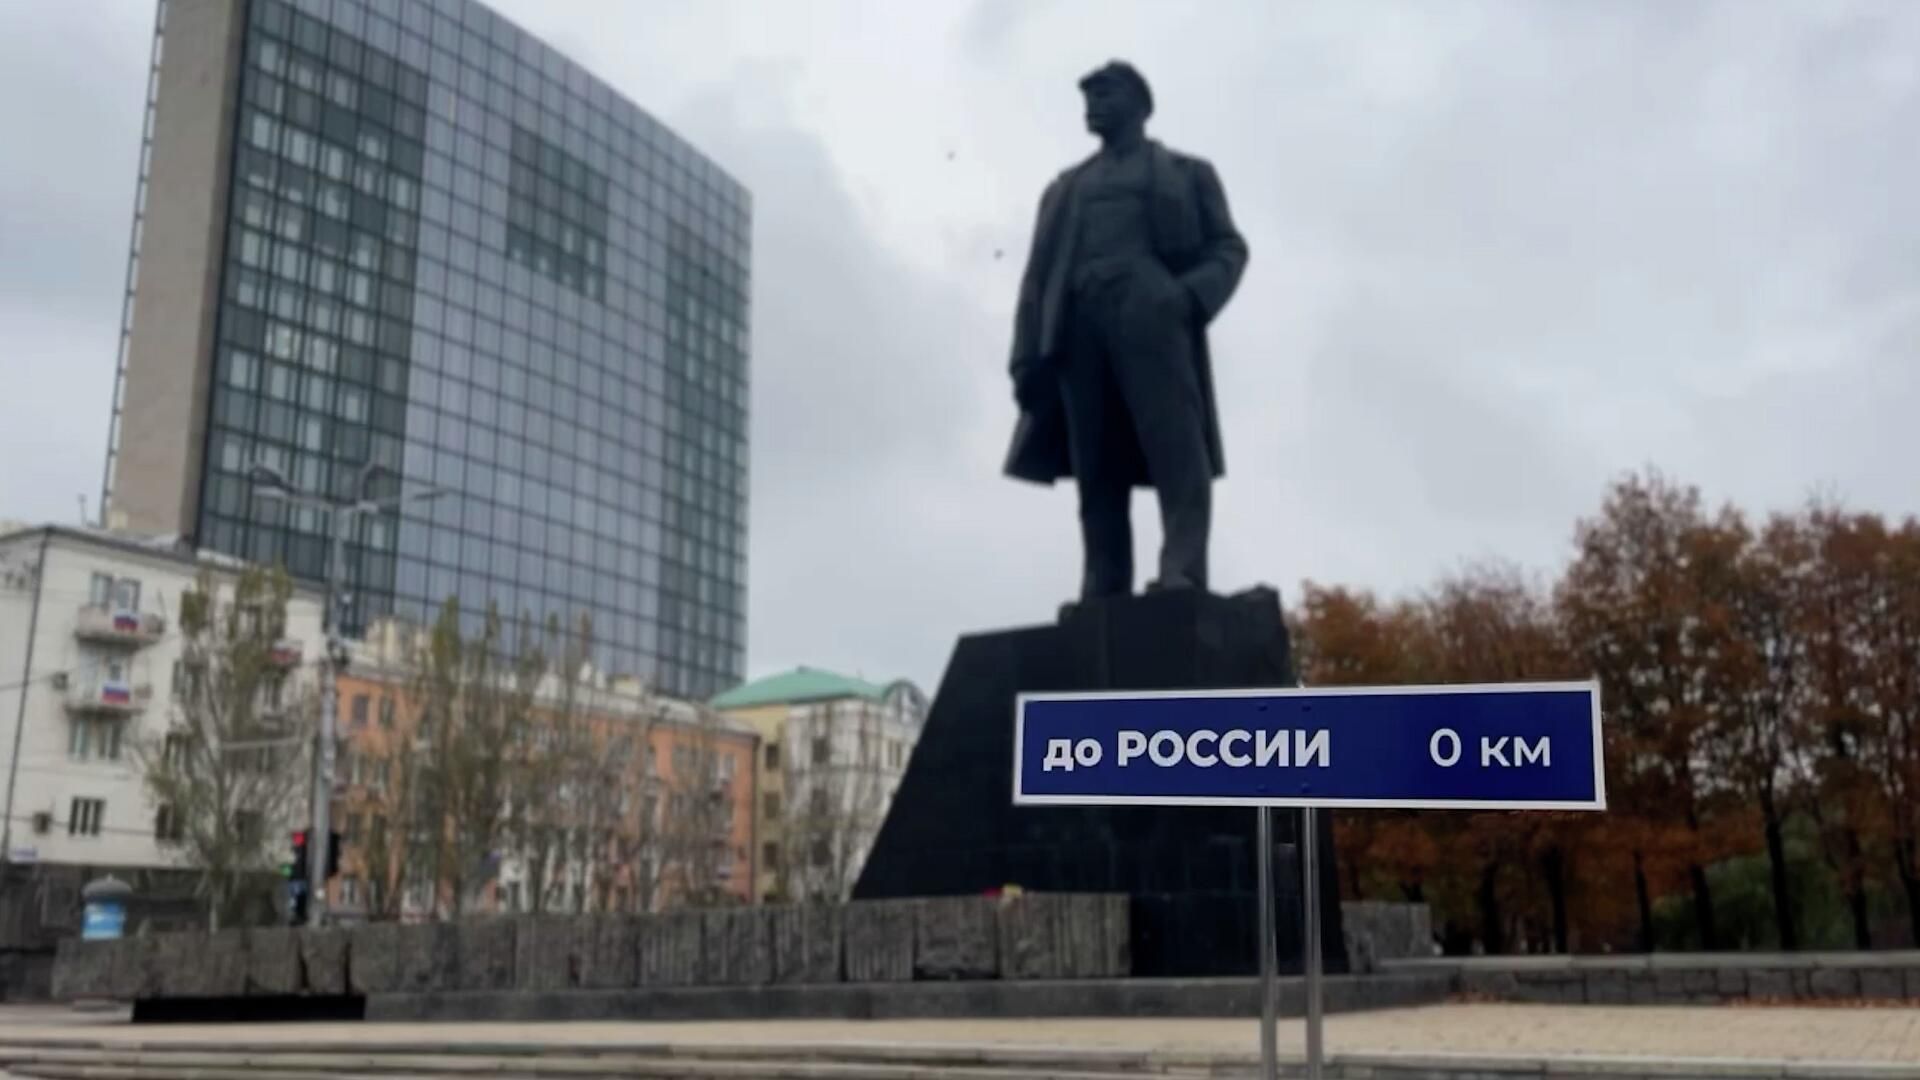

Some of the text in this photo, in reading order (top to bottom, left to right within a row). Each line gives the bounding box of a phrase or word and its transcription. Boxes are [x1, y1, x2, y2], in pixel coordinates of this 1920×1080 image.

[1042, 728, 1551, 772] до РОССИИ 0 км
